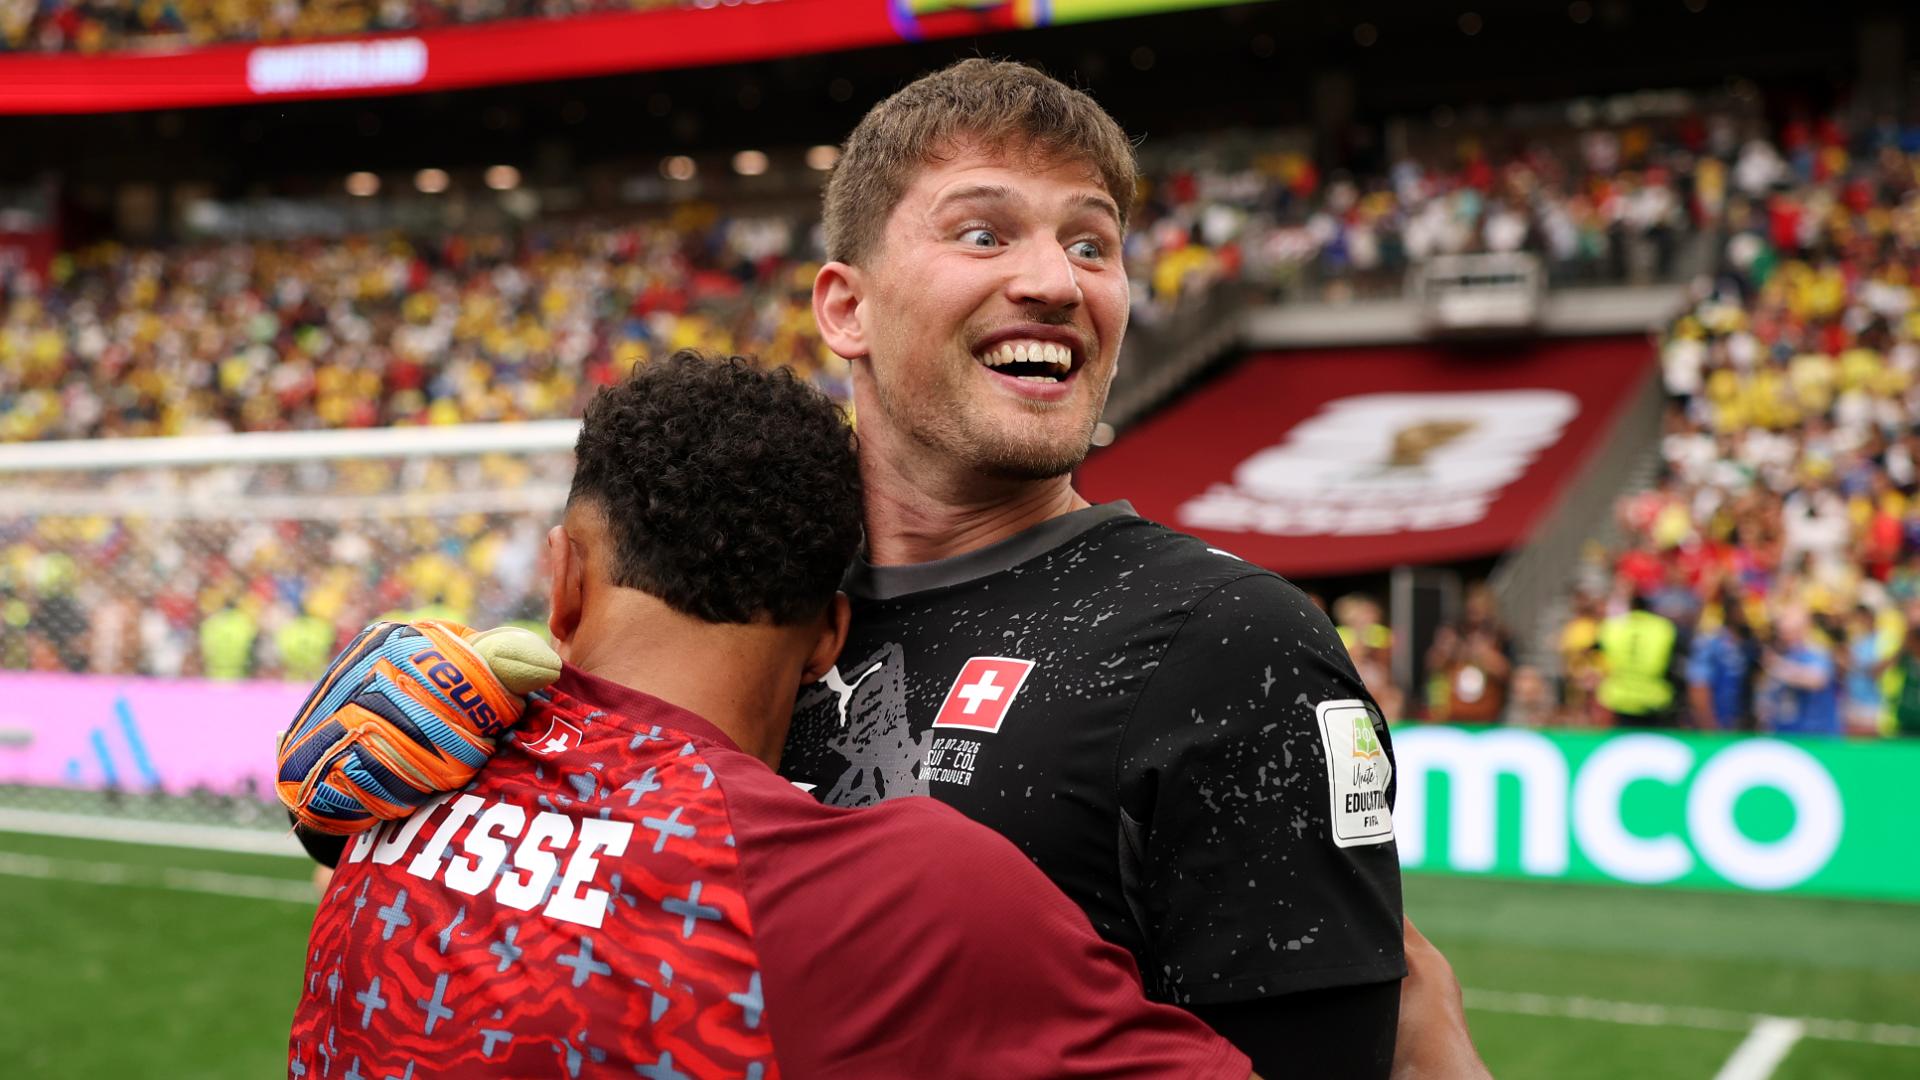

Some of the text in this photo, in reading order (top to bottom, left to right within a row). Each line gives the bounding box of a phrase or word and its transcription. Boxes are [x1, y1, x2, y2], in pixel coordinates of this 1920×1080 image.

[933, 739, 981, 753] 07.07.2026
[924, 750, 945, 765] SUI
[953, 752, 976, 771] COL
[919, 768, 972, 785] VANCOUVER
[1364, 816, 1378, 827] FIFA
